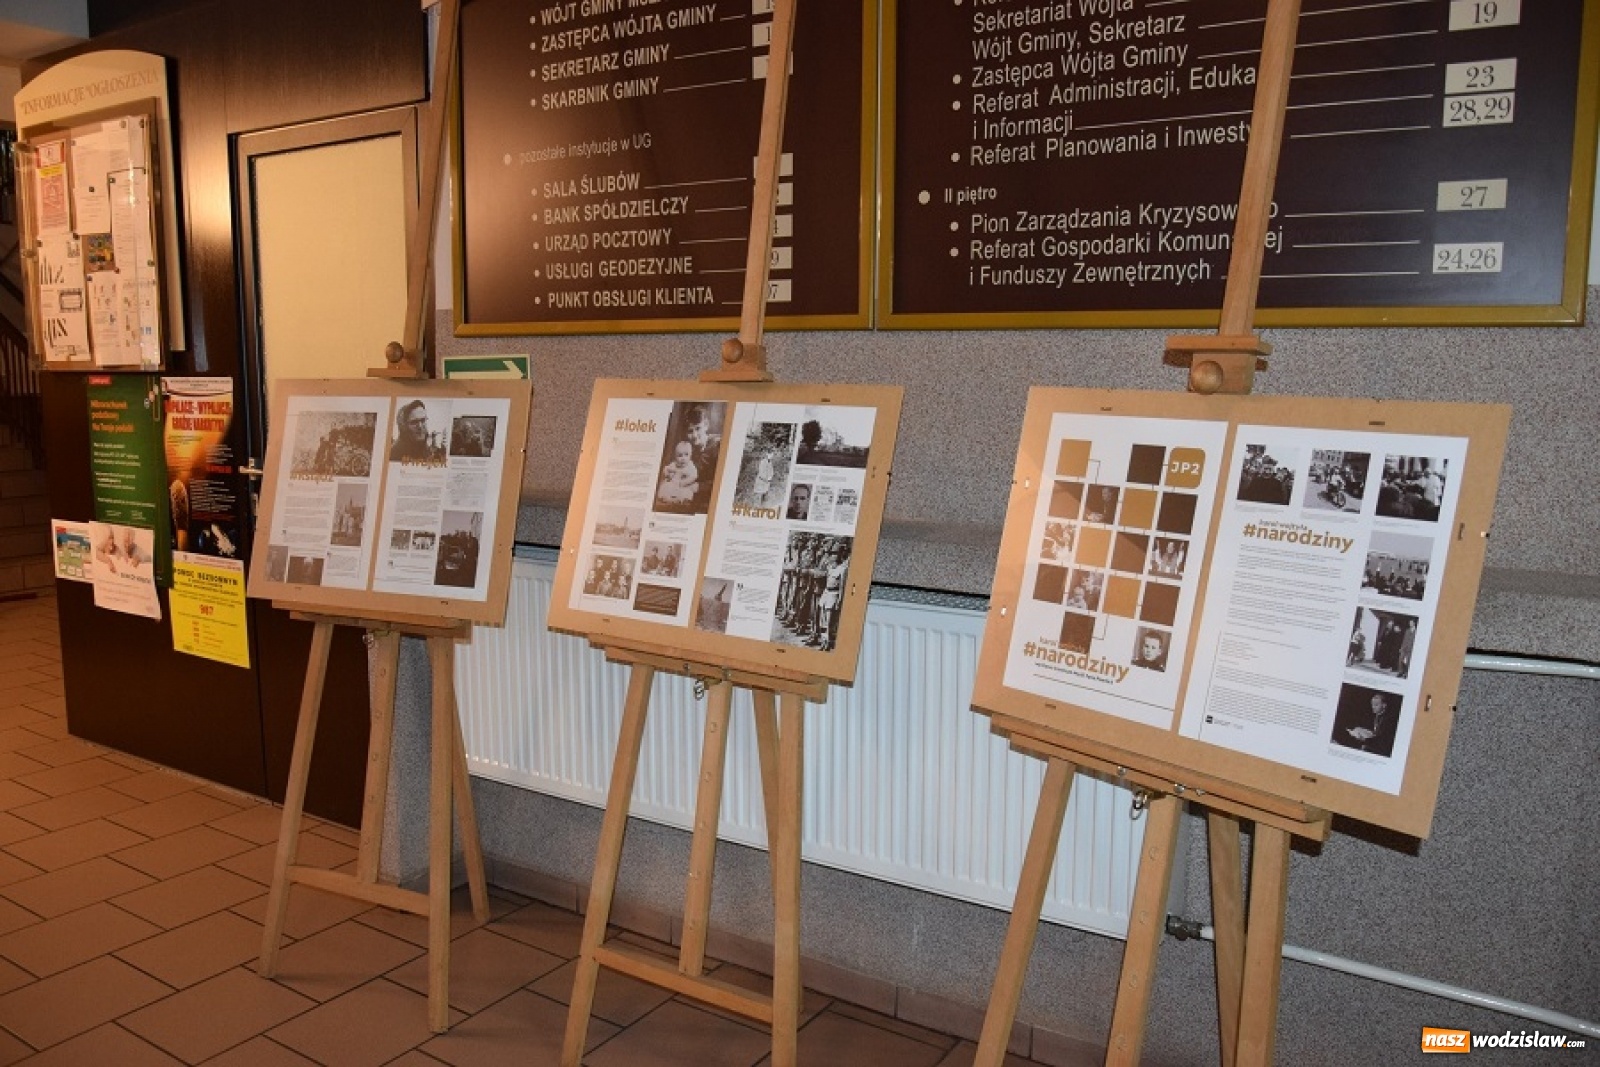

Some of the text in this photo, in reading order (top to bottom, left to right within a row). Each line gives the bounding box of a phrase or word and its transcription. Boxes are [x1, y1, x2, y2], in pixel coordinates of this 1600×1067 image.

[540, 2, 577, 25] WÓJT
[541, 3, 717, 52] ZASTĘPCA WÓJTA GMINY
[973, 1, 1072, 33] Sekretariat
[1472, 1, 1498, 25] 19
[972, 15, 1185, 62] Wójt Gminy, Sekretarz
[541, 43, 670, 82] SEKRETARZ GMINY
[972, 43, 1188, 88] Zastępca Wójta Gminy
[1466, 65, 1495, 88] 23
[541, 76, 660, 110] SKARBNIK GMINY
[973, 63, 1256, 114] Referat Administracji, Eduka
[1450, 95, 1512, 123] 28,29
[972, 110, 1073, 140] i Informacji
[520, 133, 651, 165] pozostałe instytucje w UG
[970, 141, 1035, 166] Referat
[1046, 129, 1157, 158] Planowania
[1164, 126, 1169, 148] i
[543, 170, 641, 198] SALA ŚLUBÓW
[945, 186, 997, 205] II piętro
[1460, 185, 1489, 207] 27
[544, 196, 689, 225] BANK SPÓŁDZIELCZY
[971, 202, 1278, 234] Pion Zarządzania Kryzysowo
[545, 228, 672, 253] URZĄD POCZTOWY
[970, 226, 1283, 260] Referat Gospodarki Komunej
[546, 256, 693, 279] USŁUGI GEODEZYJNE
[969, 258, 1211, 289] i Funduszy Zewnętrznych
[1437, 247, 1498, 271] 24,26
[548, 286, 714, 308] PUNKT OBSŁUGI KLIENTA
[615, 417, 657, 432] #lolek
[1171, 461, 1199, 476] JP2
[731, 502, 781, 519] #karol
[1243, 522, 1355, 554] #narodziny
[1023, 641, 1129, 683] #narodziny
